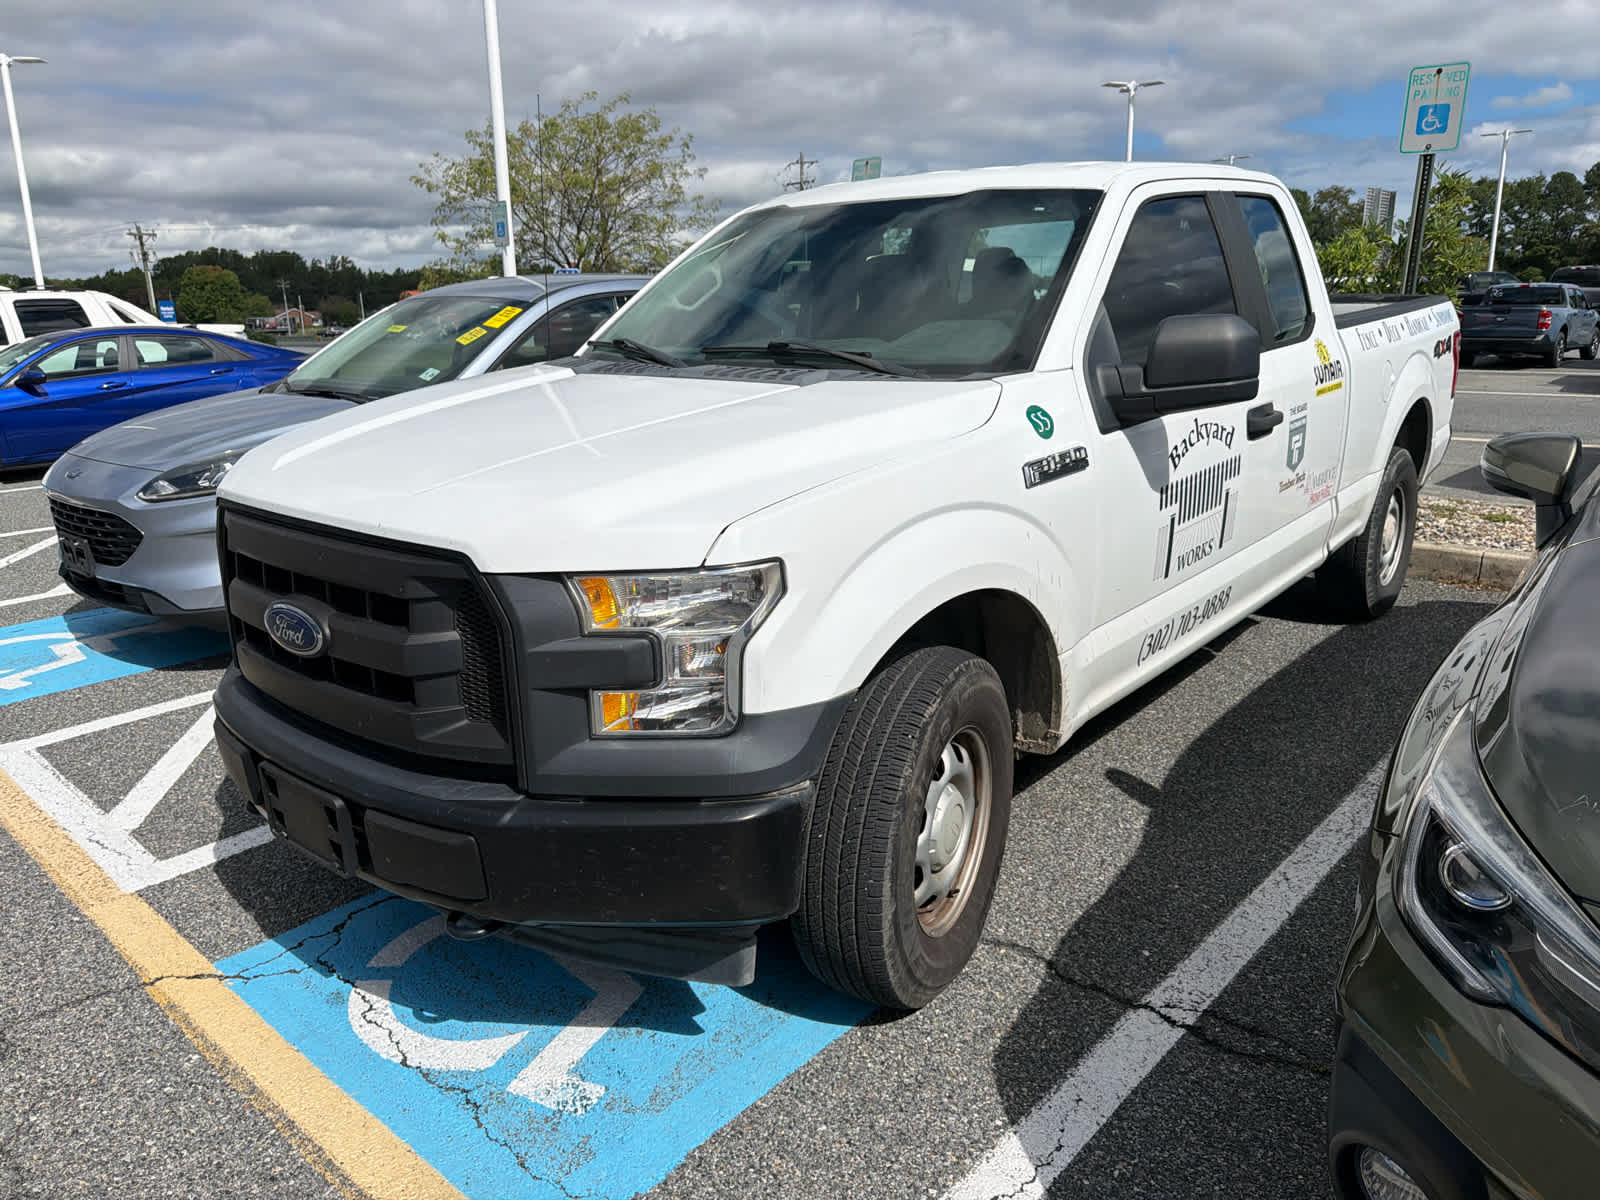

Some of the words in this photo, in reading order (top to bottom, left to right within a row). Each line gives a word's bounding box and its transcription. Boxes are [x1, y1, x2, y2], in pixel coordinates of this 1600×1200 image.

[1313, 360, 1344, 386] SUNAIR
[1168, 417, 1235, 471] Backyard
[1177, 538, 1214, 571] WORKS
[273, 613, 305, 646] Ford
[1137, 618, 1175, 666] (302)
[1174, 585, 1232, 641] 703-9888
